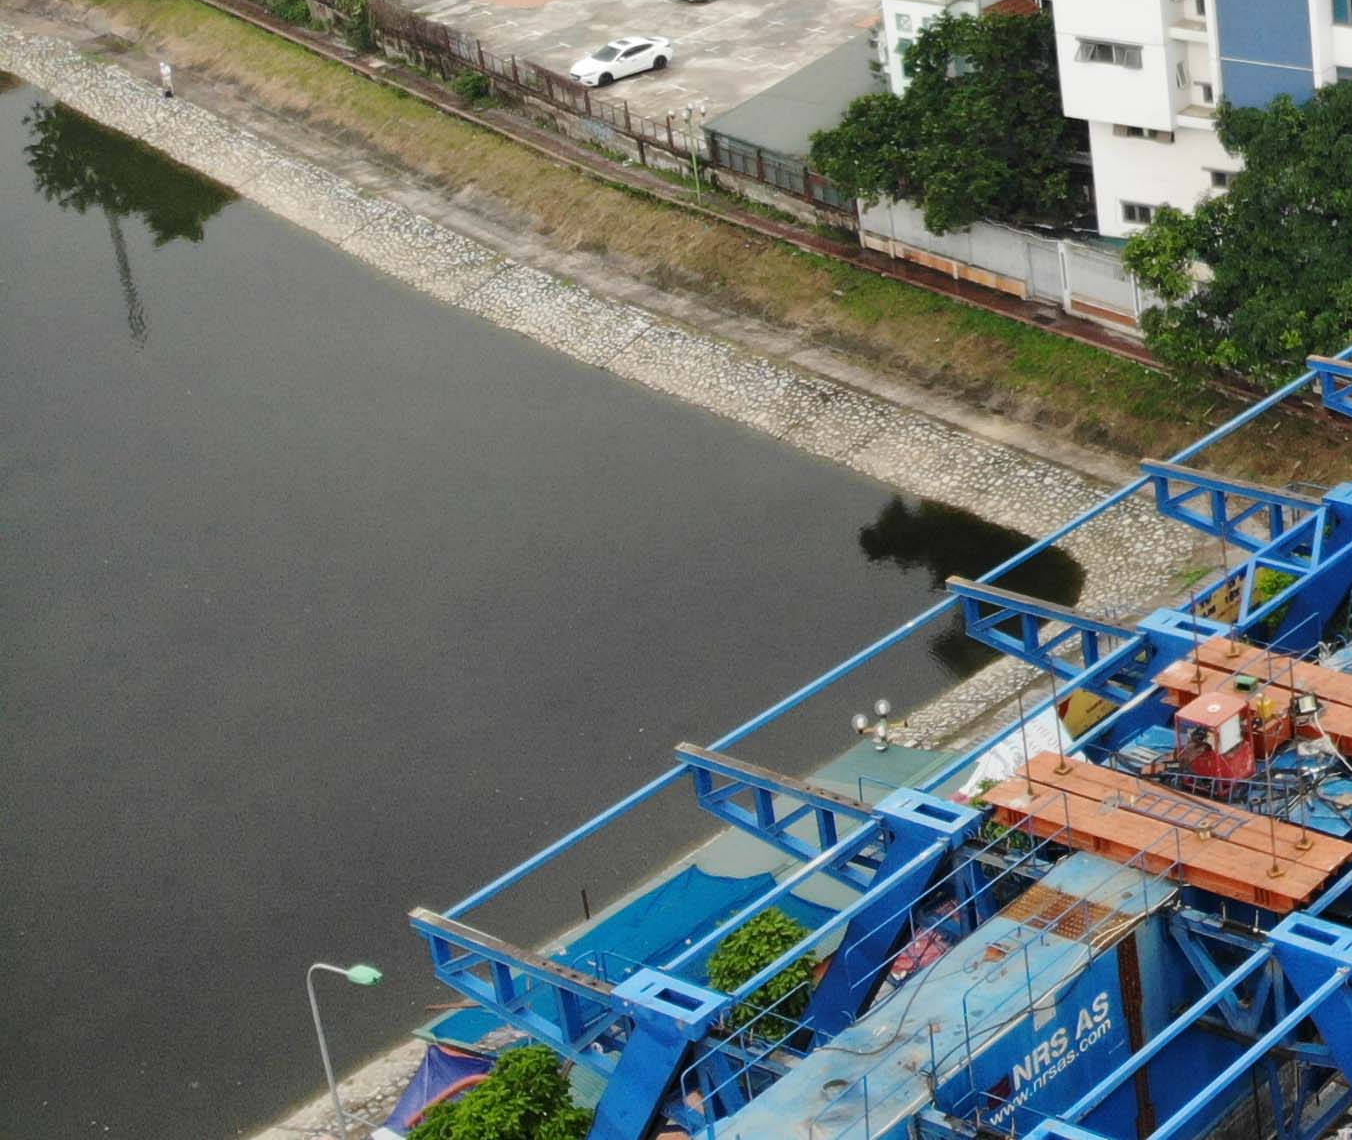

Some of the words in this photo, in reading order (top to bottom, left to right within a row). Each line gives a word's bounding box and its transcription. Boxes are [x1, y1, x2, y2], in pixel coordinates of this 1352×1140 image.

[989, 1018, 1113, 1127] www.nrsas.com
[1011, 1026, 1069, 1092] NRS
[1075, 991, 1110, 1040] AS
